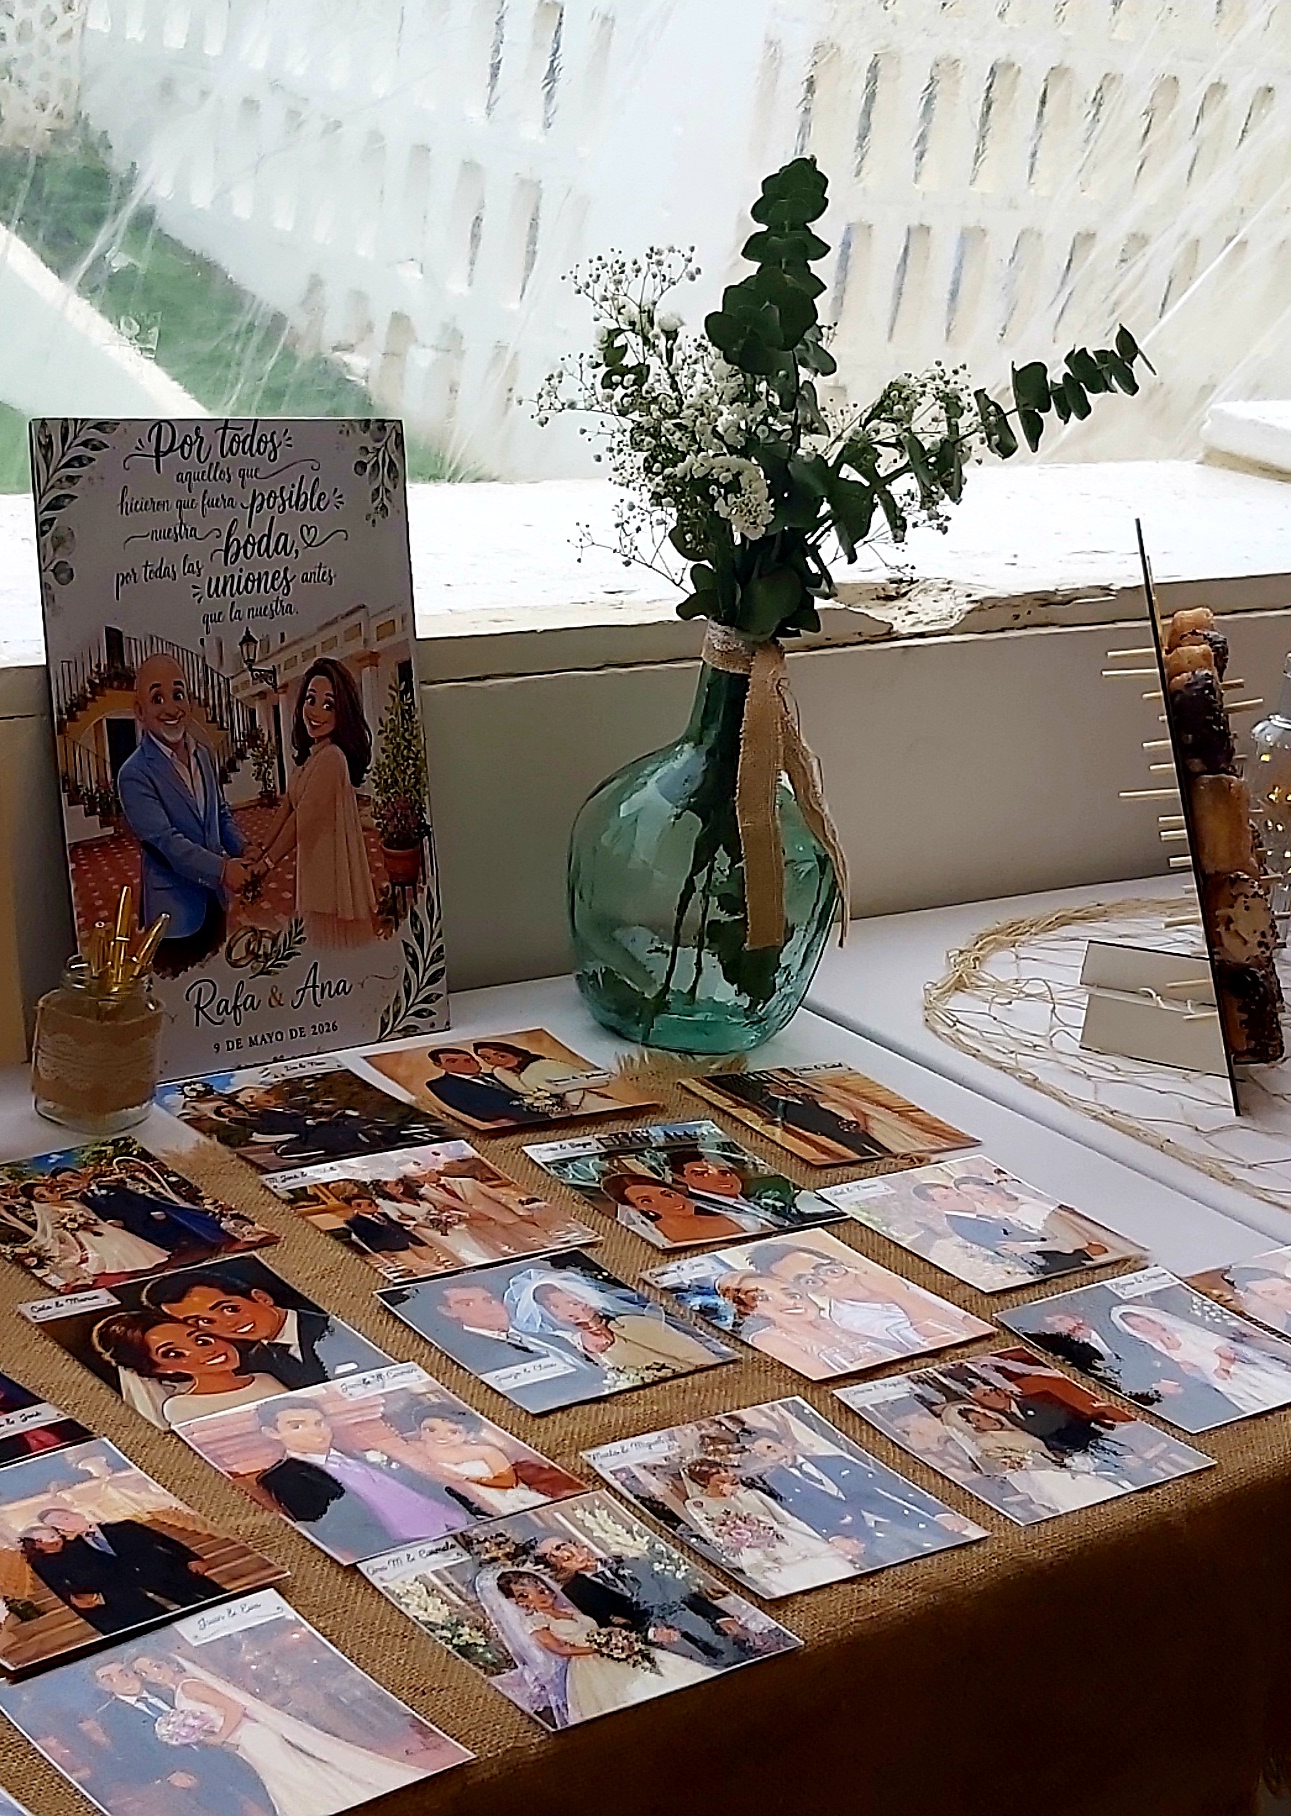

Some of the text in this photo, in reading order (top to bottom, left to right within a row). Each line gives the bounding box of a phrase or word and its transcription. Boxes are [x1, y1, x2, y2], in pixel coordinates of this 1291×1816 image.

[138, 419, 282, 474] Por todos
[176, 461, 232, 494] aquellos
[118, 477, 330, 528] hicieron que fuera posible
[218, 516, 300, 564] boda,
[115, 555, 337, 600] por todas las uniones antes
[202, 600, 299, 636] que la nuestra.
[185, 961, 353, 1028] Rafa & Ana
[213, 1020, 339, 1054] 9 DE MAYO DE 2026
